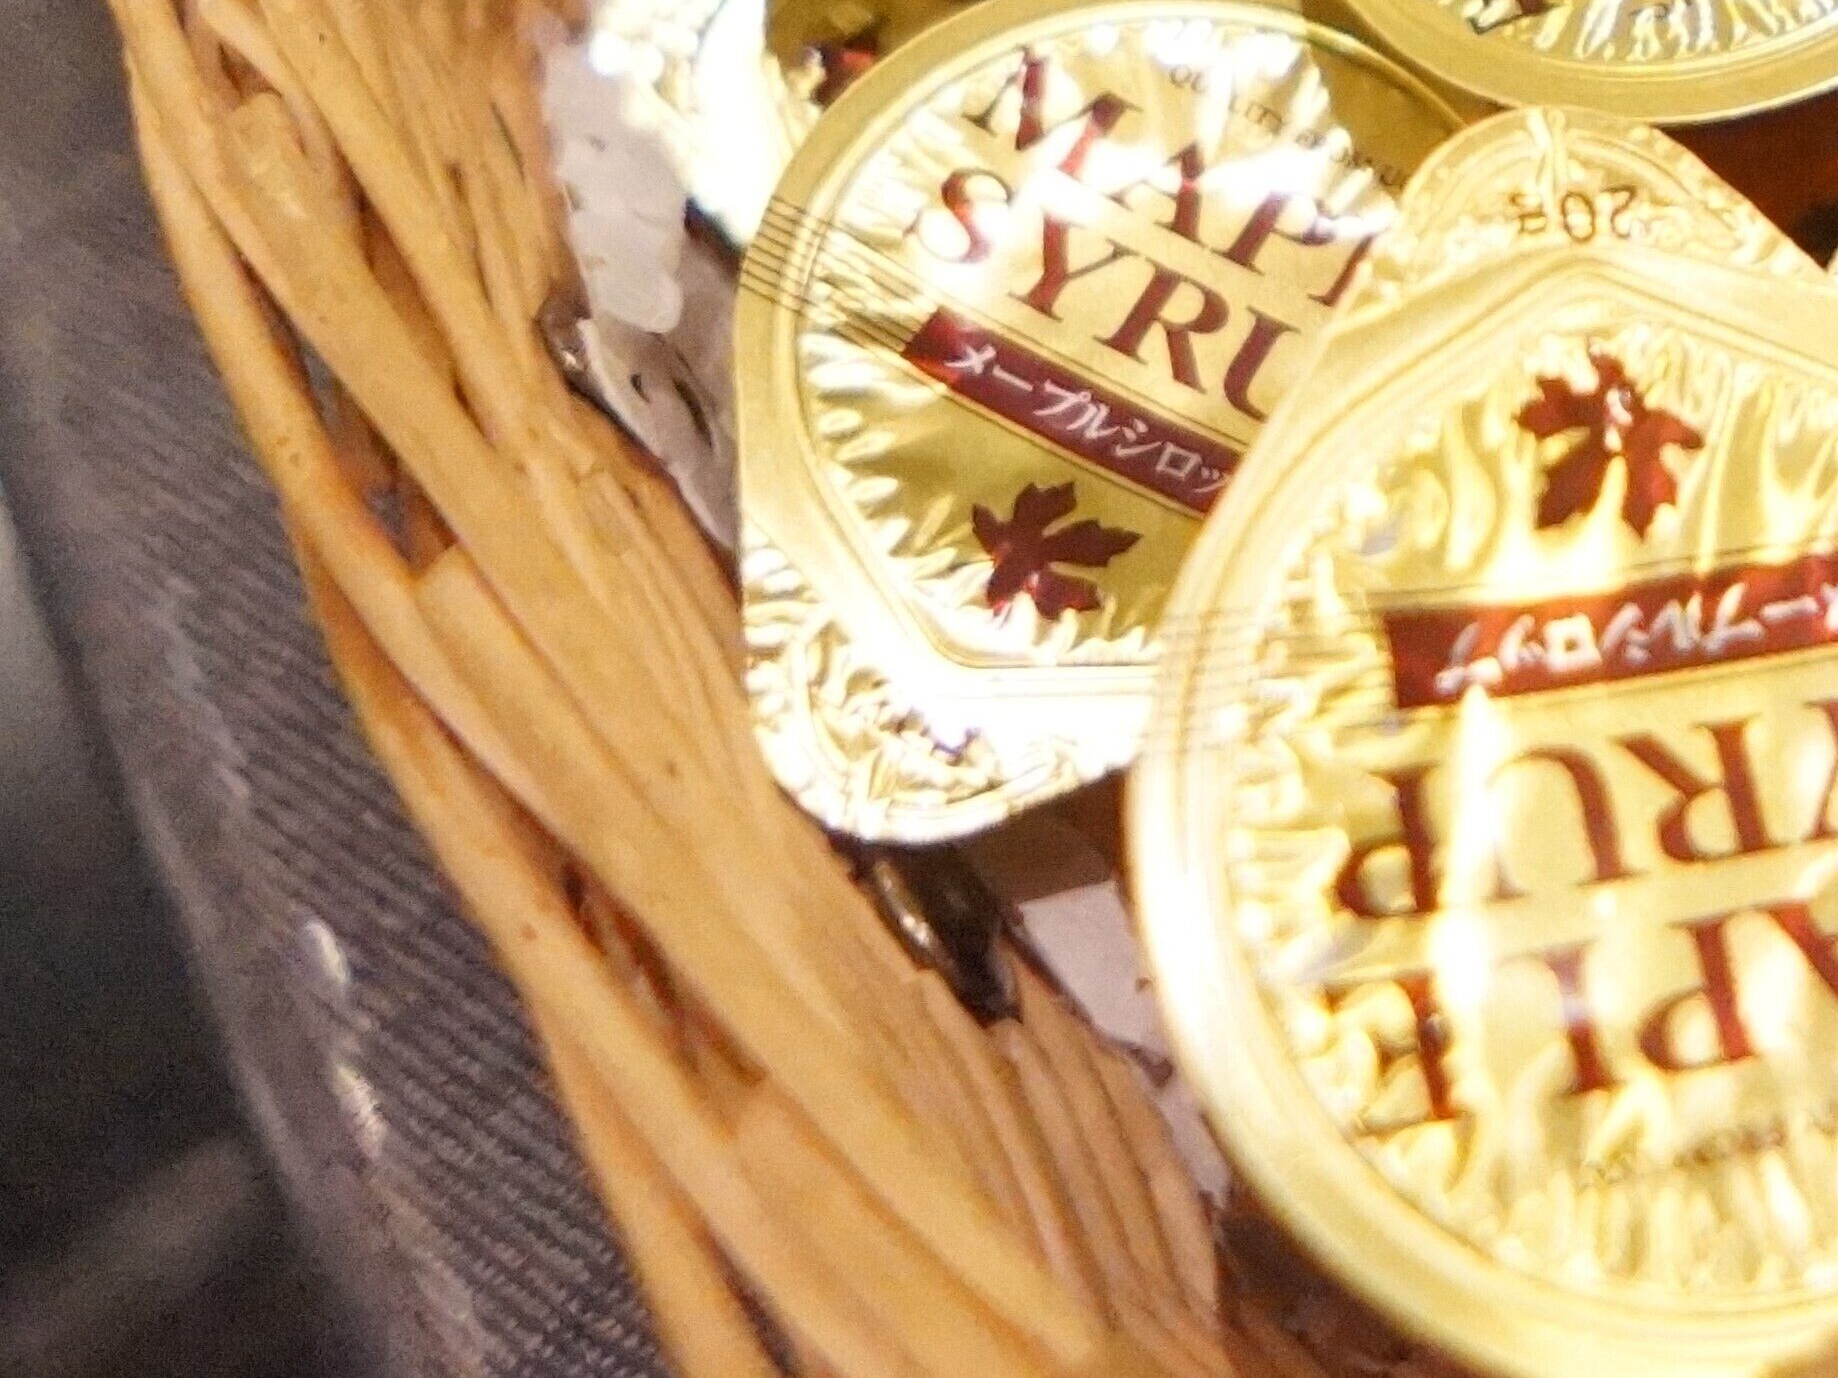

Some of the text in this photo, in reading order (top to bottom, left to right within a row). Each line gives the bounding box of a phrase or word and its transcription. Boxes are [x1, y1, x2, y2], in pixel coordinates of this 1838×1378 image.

[909, 167, 1303, 422] SYRU
[964, 45, 1379, 310] MAPL
[944, 340, 1236, 494] メープルシロッ
